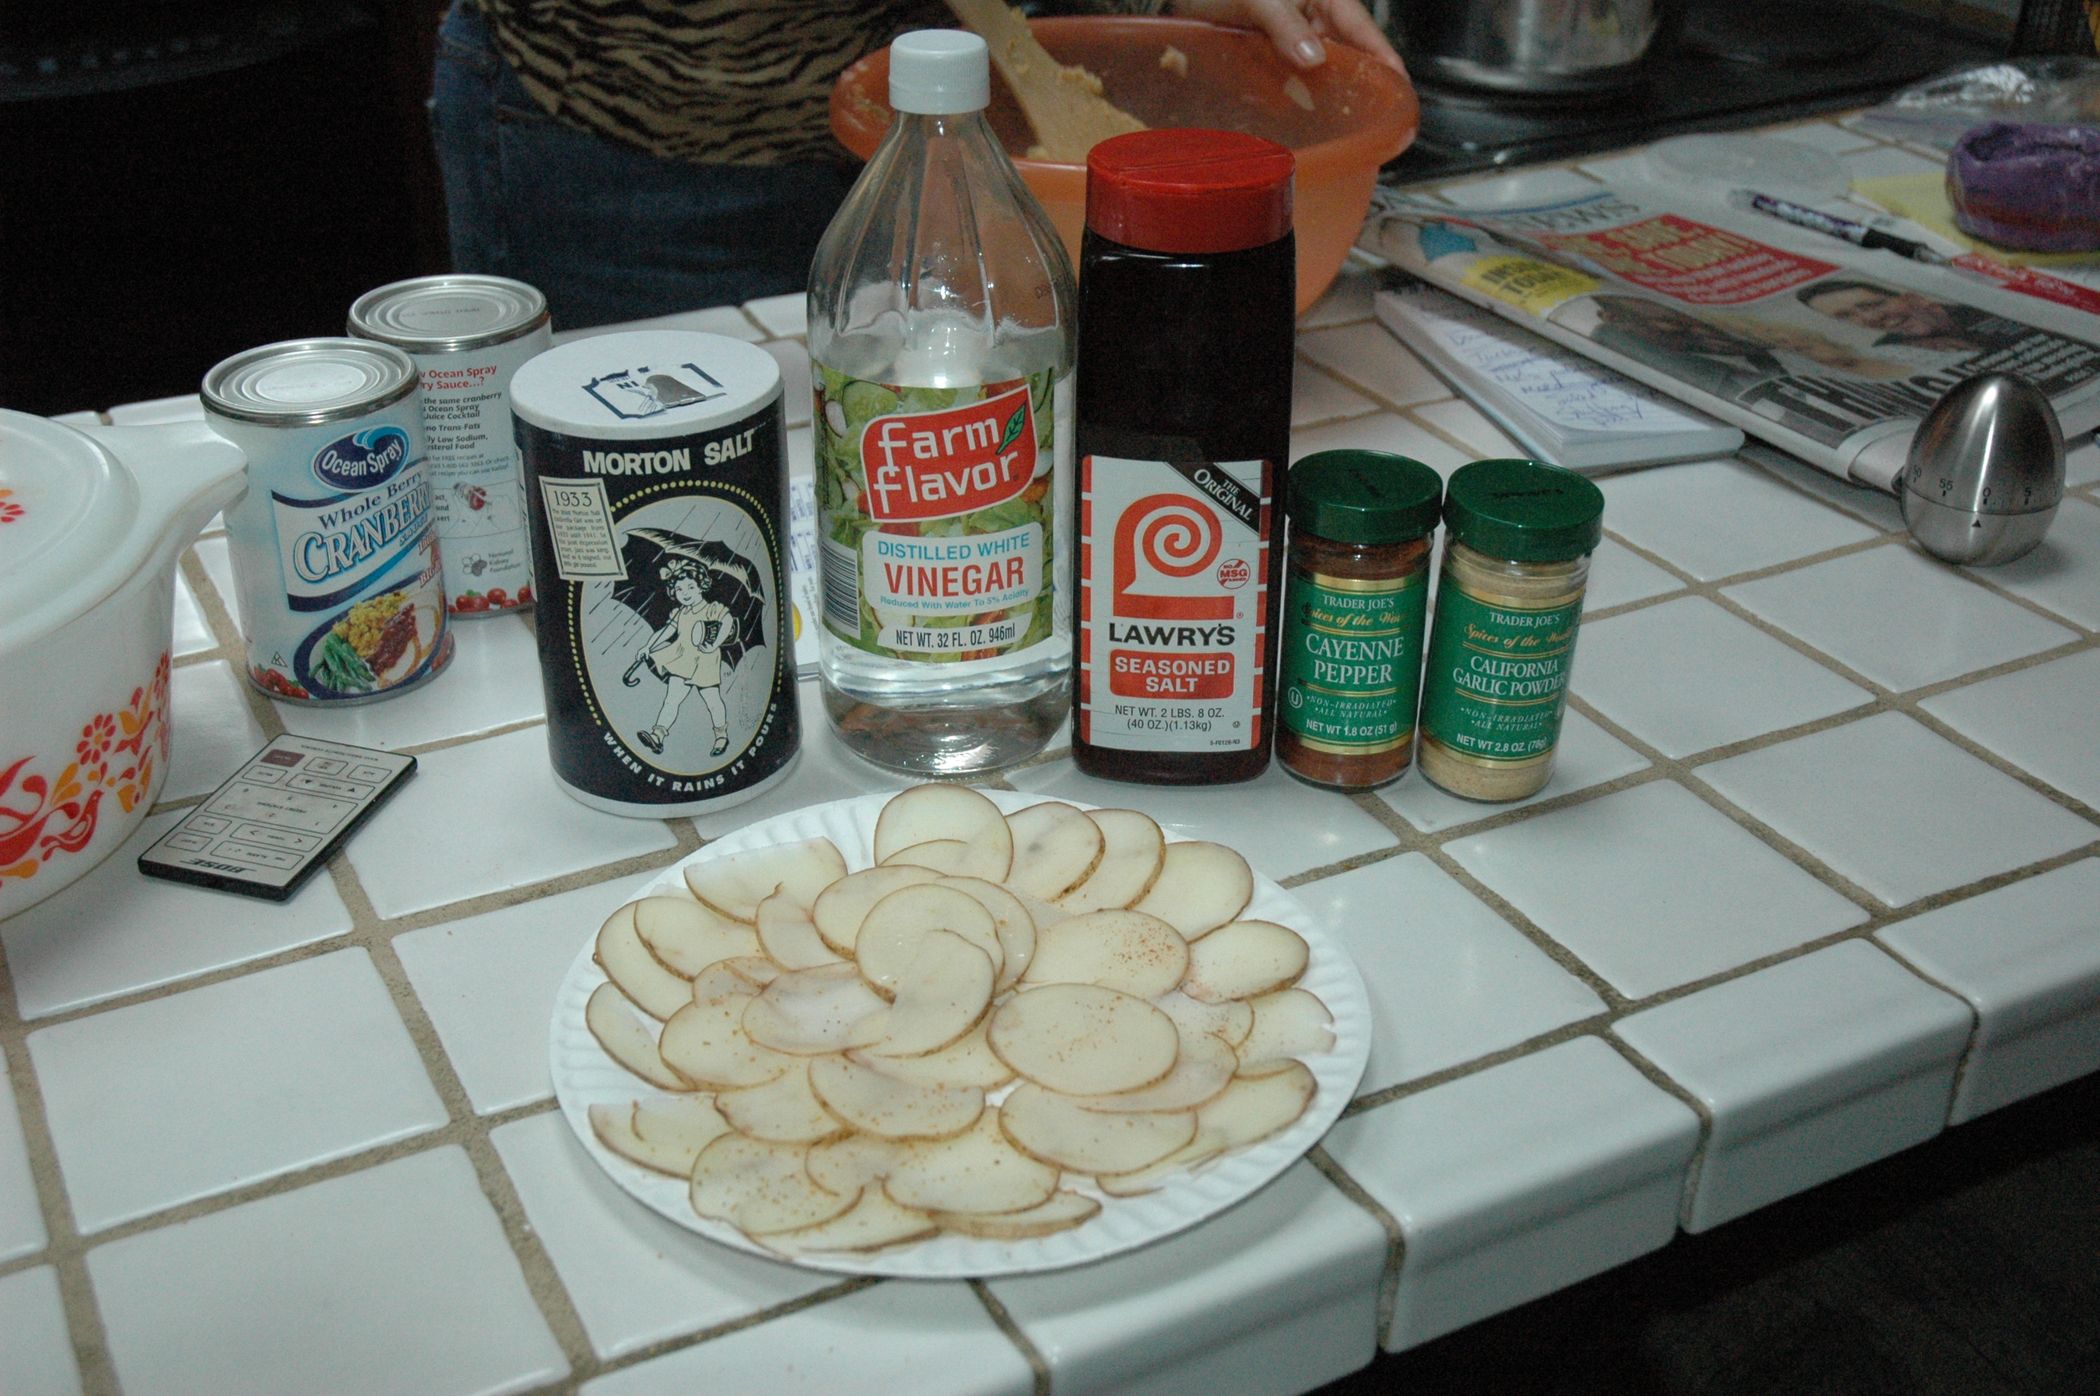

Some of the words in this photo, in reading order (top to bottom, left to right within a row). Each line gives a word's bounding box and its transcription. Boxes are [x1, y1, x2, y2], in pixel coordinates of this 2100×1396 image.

[429, 370, 464, 378] Ocean
[466, 365, 497, 378] Spray
[447, 411, 480, 420] Cocktail
[456, 404, 480, 412] Spray
[455, 442, 475, 450] Food
[582, 448, 691, 476] MORTON
[704, 428, 755, 466] SALT
[321, 450, 367, 477] Ocean
[366, 439, 402, 473] Spray
[874, 450, 1019, 514] flavor
[1222, 479, 1240, 494] THE
[1938, 478, 1954, 491] 55
[1982, 486, 1992, 498] 0
[2024, 486, 2032, 498] 5
[318, 495, 380, 530] Whole
[386, 470, 422, 499] Berry
[554, 490, 592, 507] 1933
[1194, 468, 1253, 520] ORIGINAL
[878, 540, 972, 561] DISTILLED
[978, 532, 1030, 557] WHITE
[884, 556, 1024, 598] VINEGAR
[1220, 568, 1248, 578] MSG
[880, 595, 919, 610] Reduced
[921, 598, 942, 610] With
[945, 598, 971, 610] Water
[974, 598, 986, 608] To
[1002, 588, 1030, 602] Acidity
[1322, 594, 1366, 609] TRADER
[1366, 598, 1394, 612] JOE'S
[1336, 613, 1355, 627] of
[1352, 614, 1374, 626] the
[1490, 612, 1534, 628] TRADER
[1534, 613, 1560, 628] JOE'S
[896, 630, 914, 646] NET
[916, 633, 934, 648] WT.
[937, 633, 949, 648] 32
[952, 632, 967, 647] FL.
[970, 630, 986, 646] OZ.
[988, 622, 1015, 641] 946ml
[1108, 622, 1236, 646] LAWRY'S
[1464, 623, 1499, 643] Spices
[1504, 635, 1520, 648] of
[1520, 635, 1541, 647] the
[1306, 633, 1404, 661] CAYENNE
[1115, 656, 1231, 676] SEASONED
[1314, 660, 1392, 685] PEPPER
[1470, 656, 1558, 678] CALIFORNIA
[1146, 677, 1198, 692] SALT
[1452, 667, 1508, 696] GARLIC
[1115, 704, 1136, 716] NET
[1138, 708, 1158, 718] WT.
[1160, 708, 1168, 718] 2
[1170, 708, 1194, 718] LBS.
[1198, 708, 1204, 718] 8
[1208, 708, 1224, 718] OZ.
[1127, 718, 1144, 730] (40
[1306, 719, 1324, 732] NET
[1326, 724, 1342, 735] WT
[1344, 725, 1358, 736] 1.8
[1360, 726, 1374, 736] OZ
[1374, 724, 1387, 736] (51
[1390, 721, 1398, 734] g)
[603, 730, 642, 775] WHEN
[648, 773, 665, 787] IT
[672, 773, 725, 792] RAINS
[731, 759, 745, 776] IT
[748, 702, 778, 757] POURS
[1456, 732, 1476, 747] NET
[1478, 738, 1494, 750] WT
[1511, 742, 1526, 752] OZ
